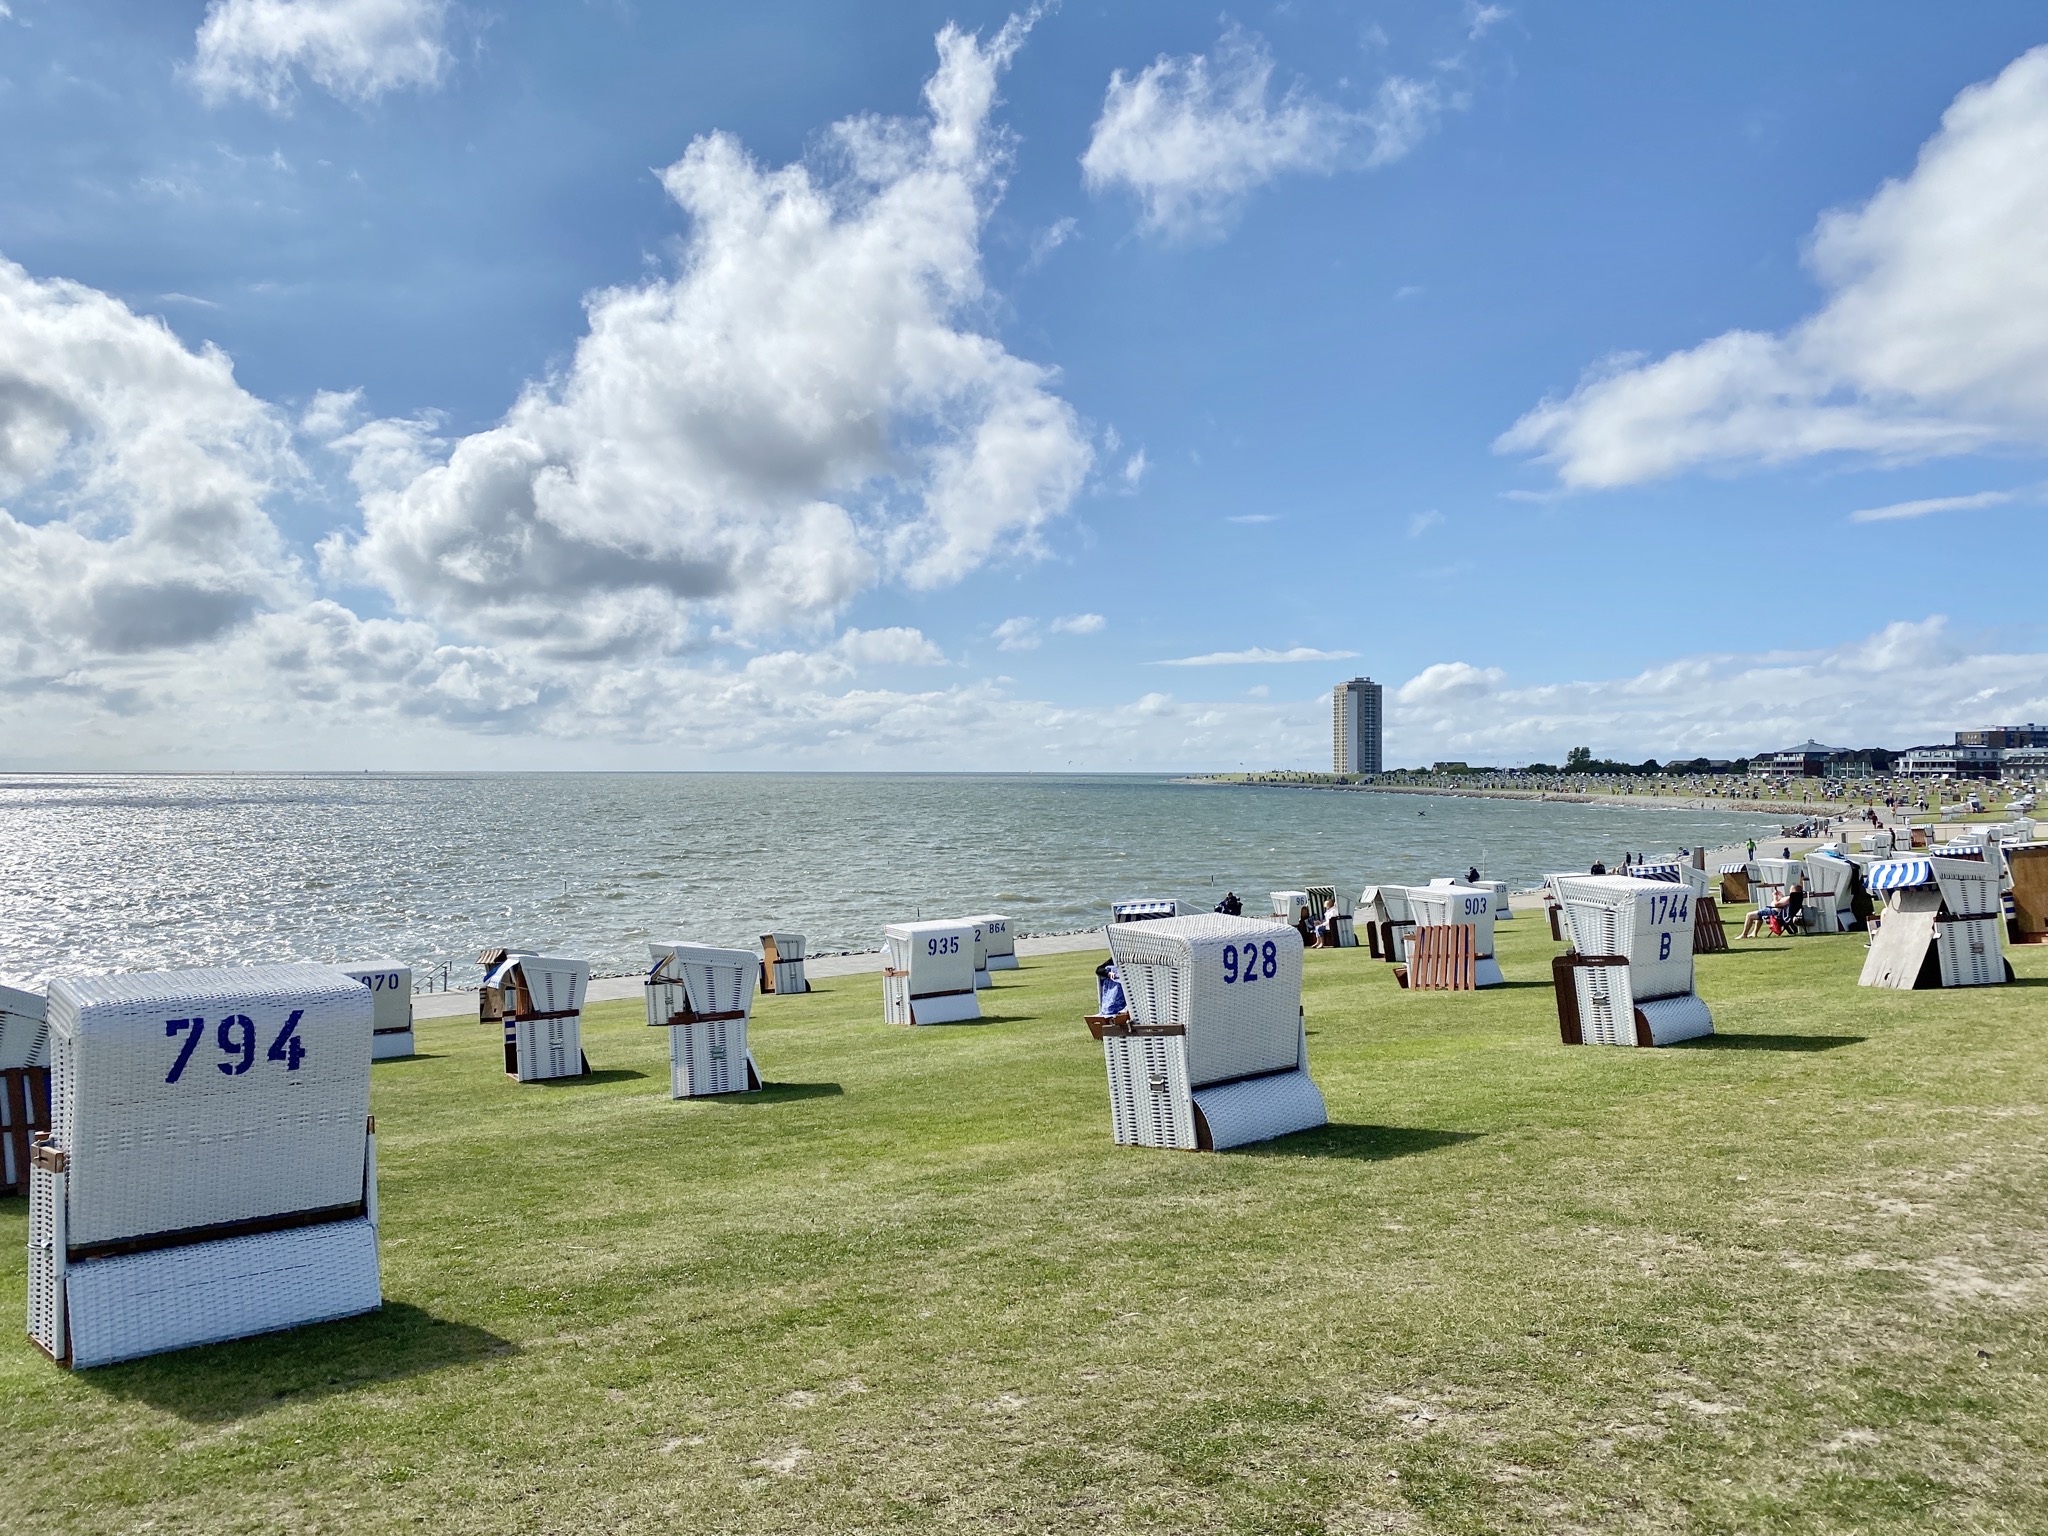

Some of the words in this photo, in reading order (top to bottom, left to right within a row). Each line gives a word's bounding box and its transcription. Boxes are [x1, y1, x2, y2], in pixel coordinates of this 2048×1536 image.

[1464, 897, 1487, 915] 903
[1651, 894, 1688, 925] 1744
[989, 922, 1006, 934] 864
[928, 936, 959, 956] 935
[1659, 932, 1671, 961] B
[1223, 940, 1277, 984] 928
[165, 1009, 306, 1084] 794
